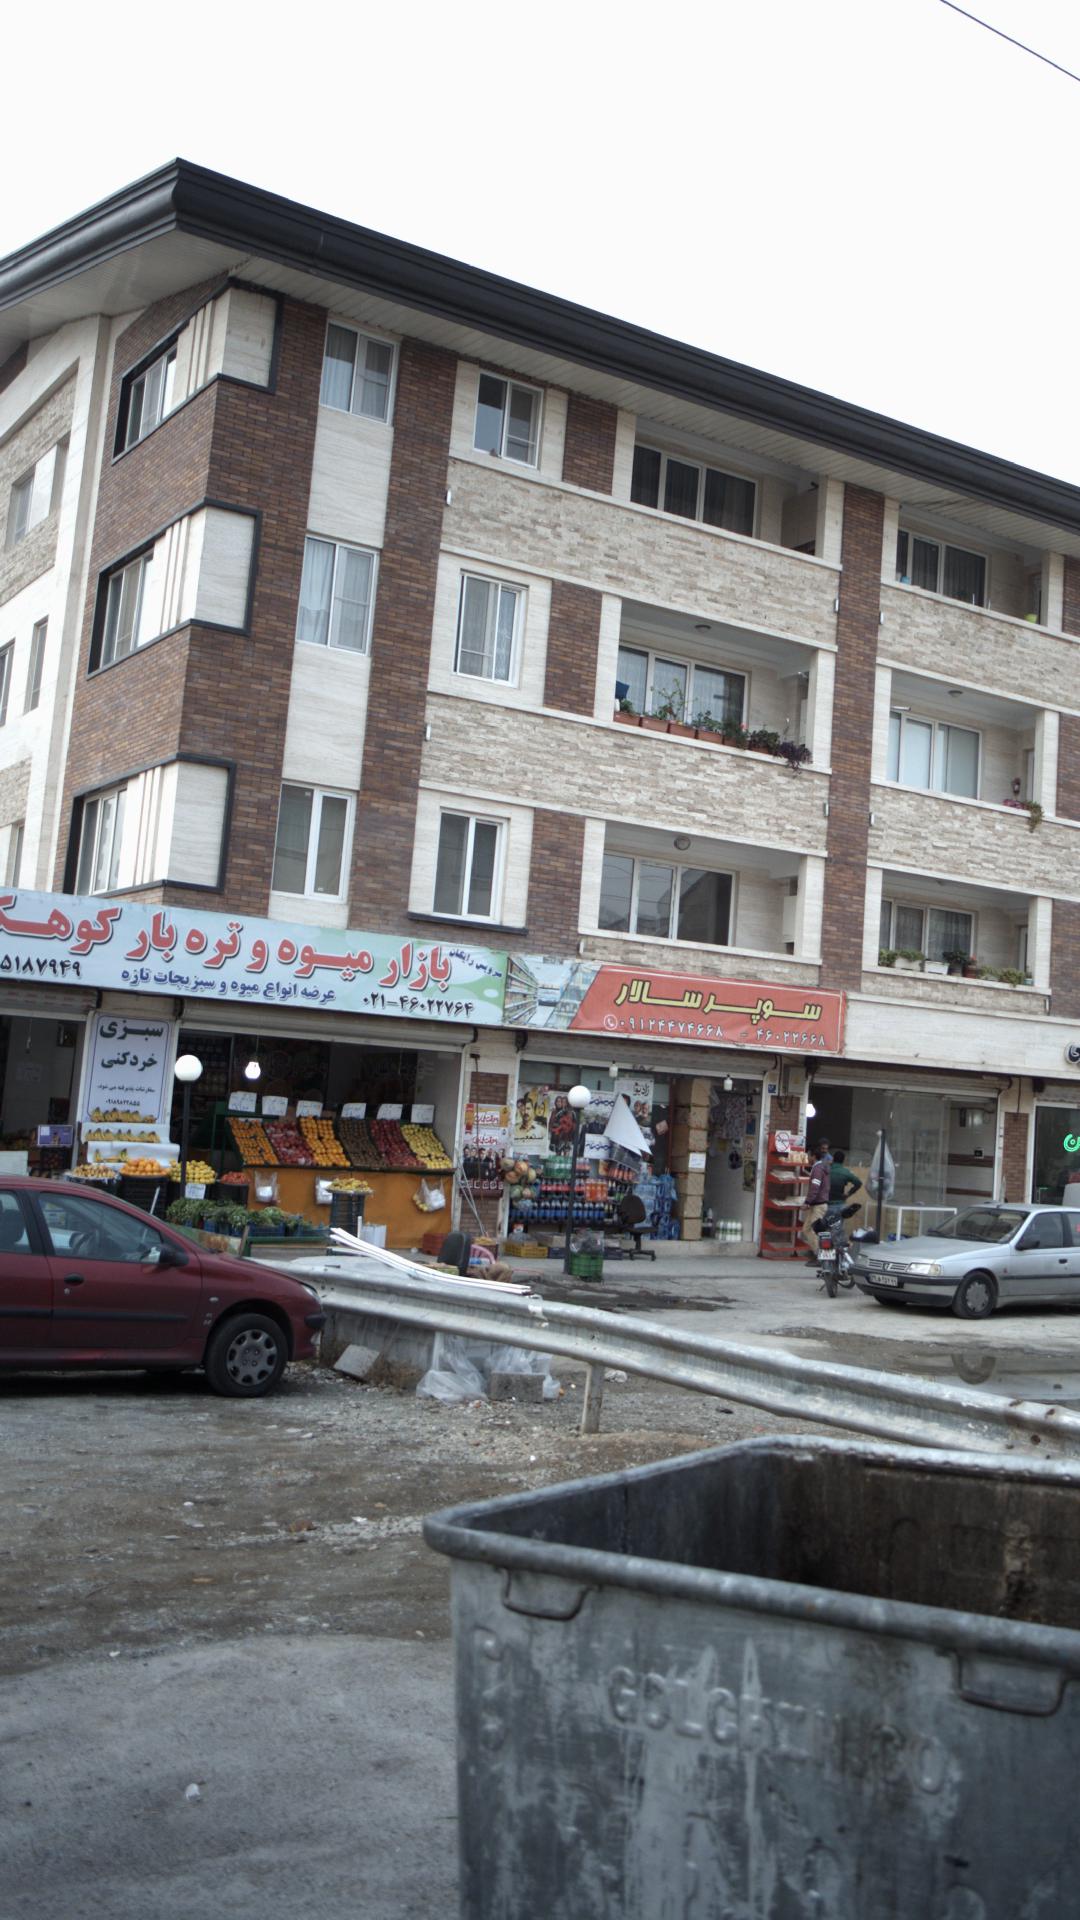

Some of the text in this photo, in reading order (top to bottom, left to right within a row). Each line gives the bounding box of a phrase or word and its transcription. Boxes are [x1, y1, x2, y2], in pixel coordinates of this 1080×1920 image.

[124, 911, 177, 962] بار
[184, 920, 243, 970] تره
[0, 954, 80, 977] ۵۱۸۷۹۴۹
[244, 937, 269, 973] و
[277, 937, 373, 981] میوه
[121, 967, 150, 984] تازه
[379, 942, 451, 991] بازار
[219, 979, 227, 992] و
[230, 979, 259, 996] میوه
[263, 982, 298, 999] انواع
[300, 989, 336, 1003] عرضه
[615, 979, 822, 1025] سوپر سالار
[100, 1019, 163, 1041] سبزی
[756, 1028, 825, 1046] ۴۶۰۲۲۶۶۸
